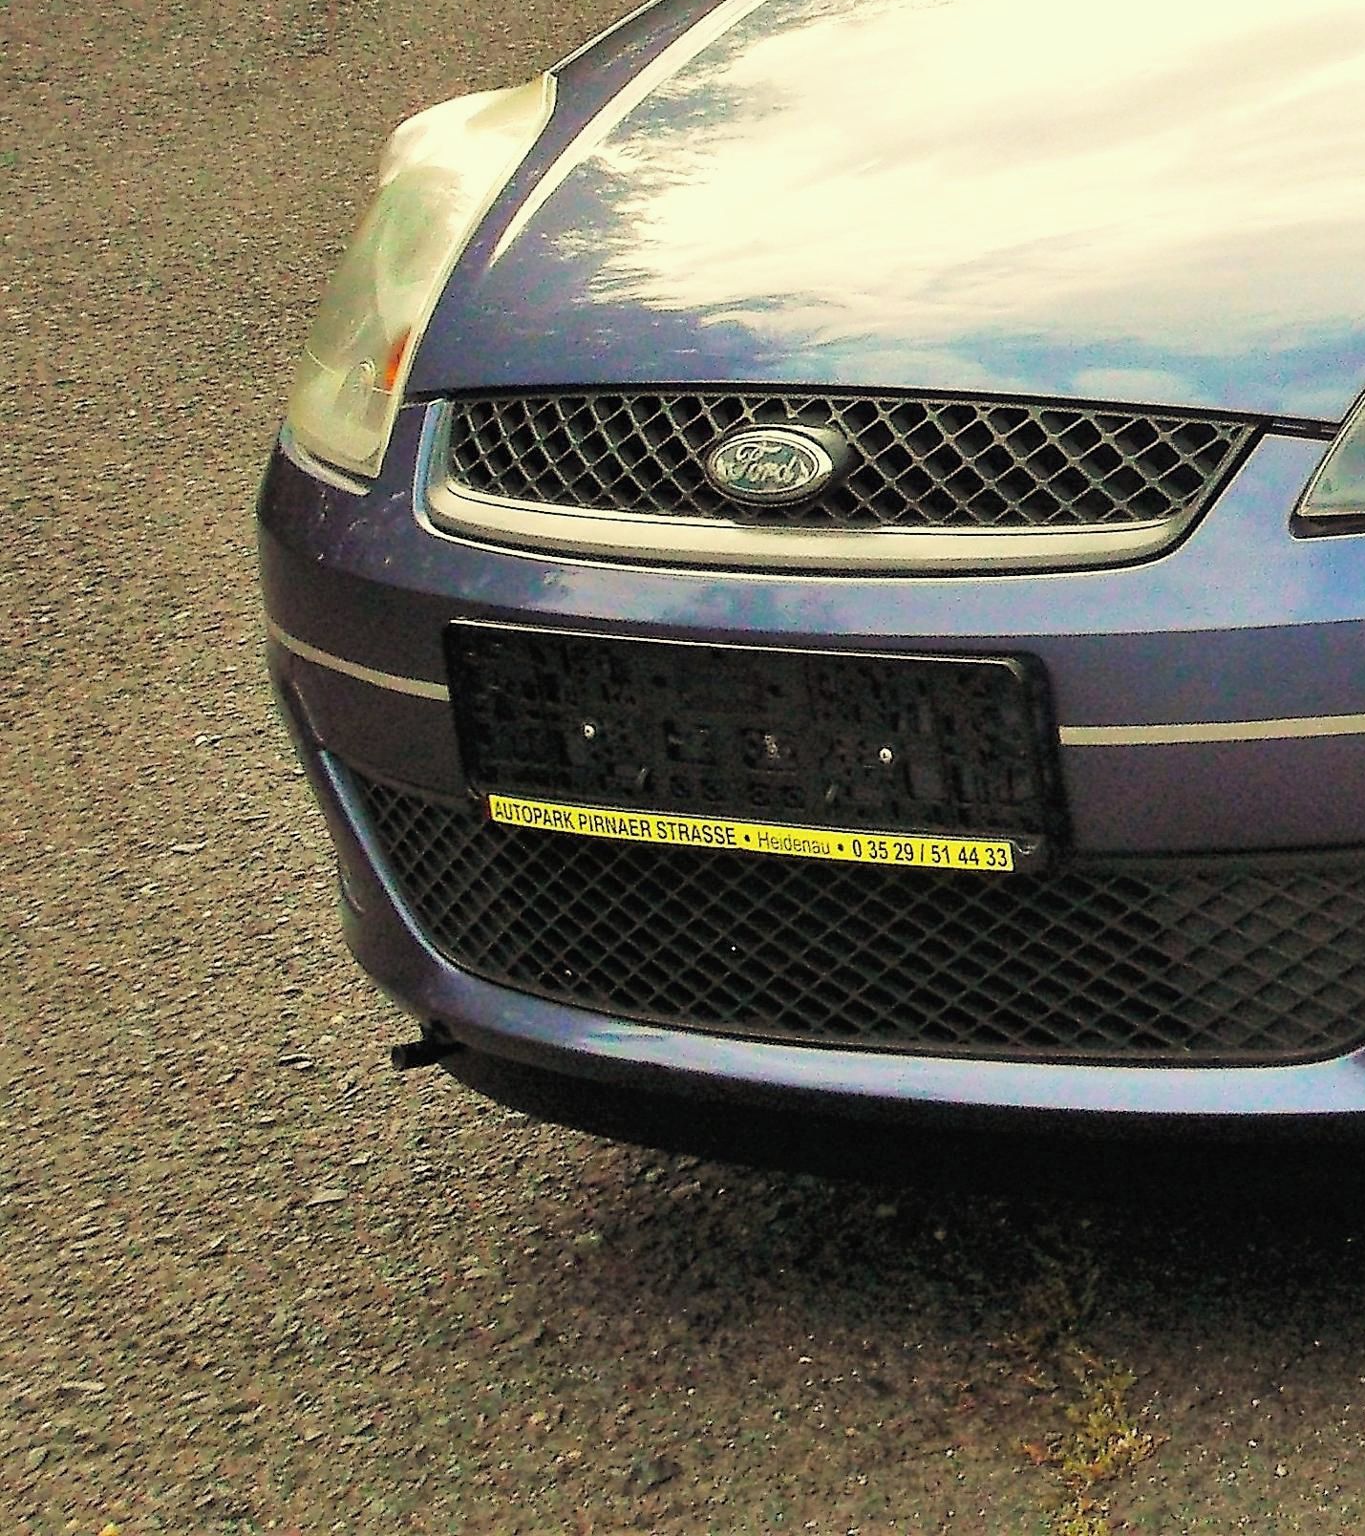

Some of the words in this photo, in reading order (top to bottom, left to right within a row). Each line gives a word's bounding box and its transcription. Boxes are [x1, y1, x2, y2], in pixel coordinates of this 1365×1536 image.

[729, 441, 798, 483] Ford
[495, 801, 575, 830] AUTOPARK
[578, 814, 652, 838] PIRNAER
[656, 821, 737, 845] STRASSE
[758, 831, 831, 855] Heidenau
[852, 839, 863, 858] 0
[867, 840, 889, 859] 35
[894, 842, 914, 862] 29
[931, 844, 951, 863] 51
[958, 847, 979, 865] 44
[985, 848, 1009, 867] 33
